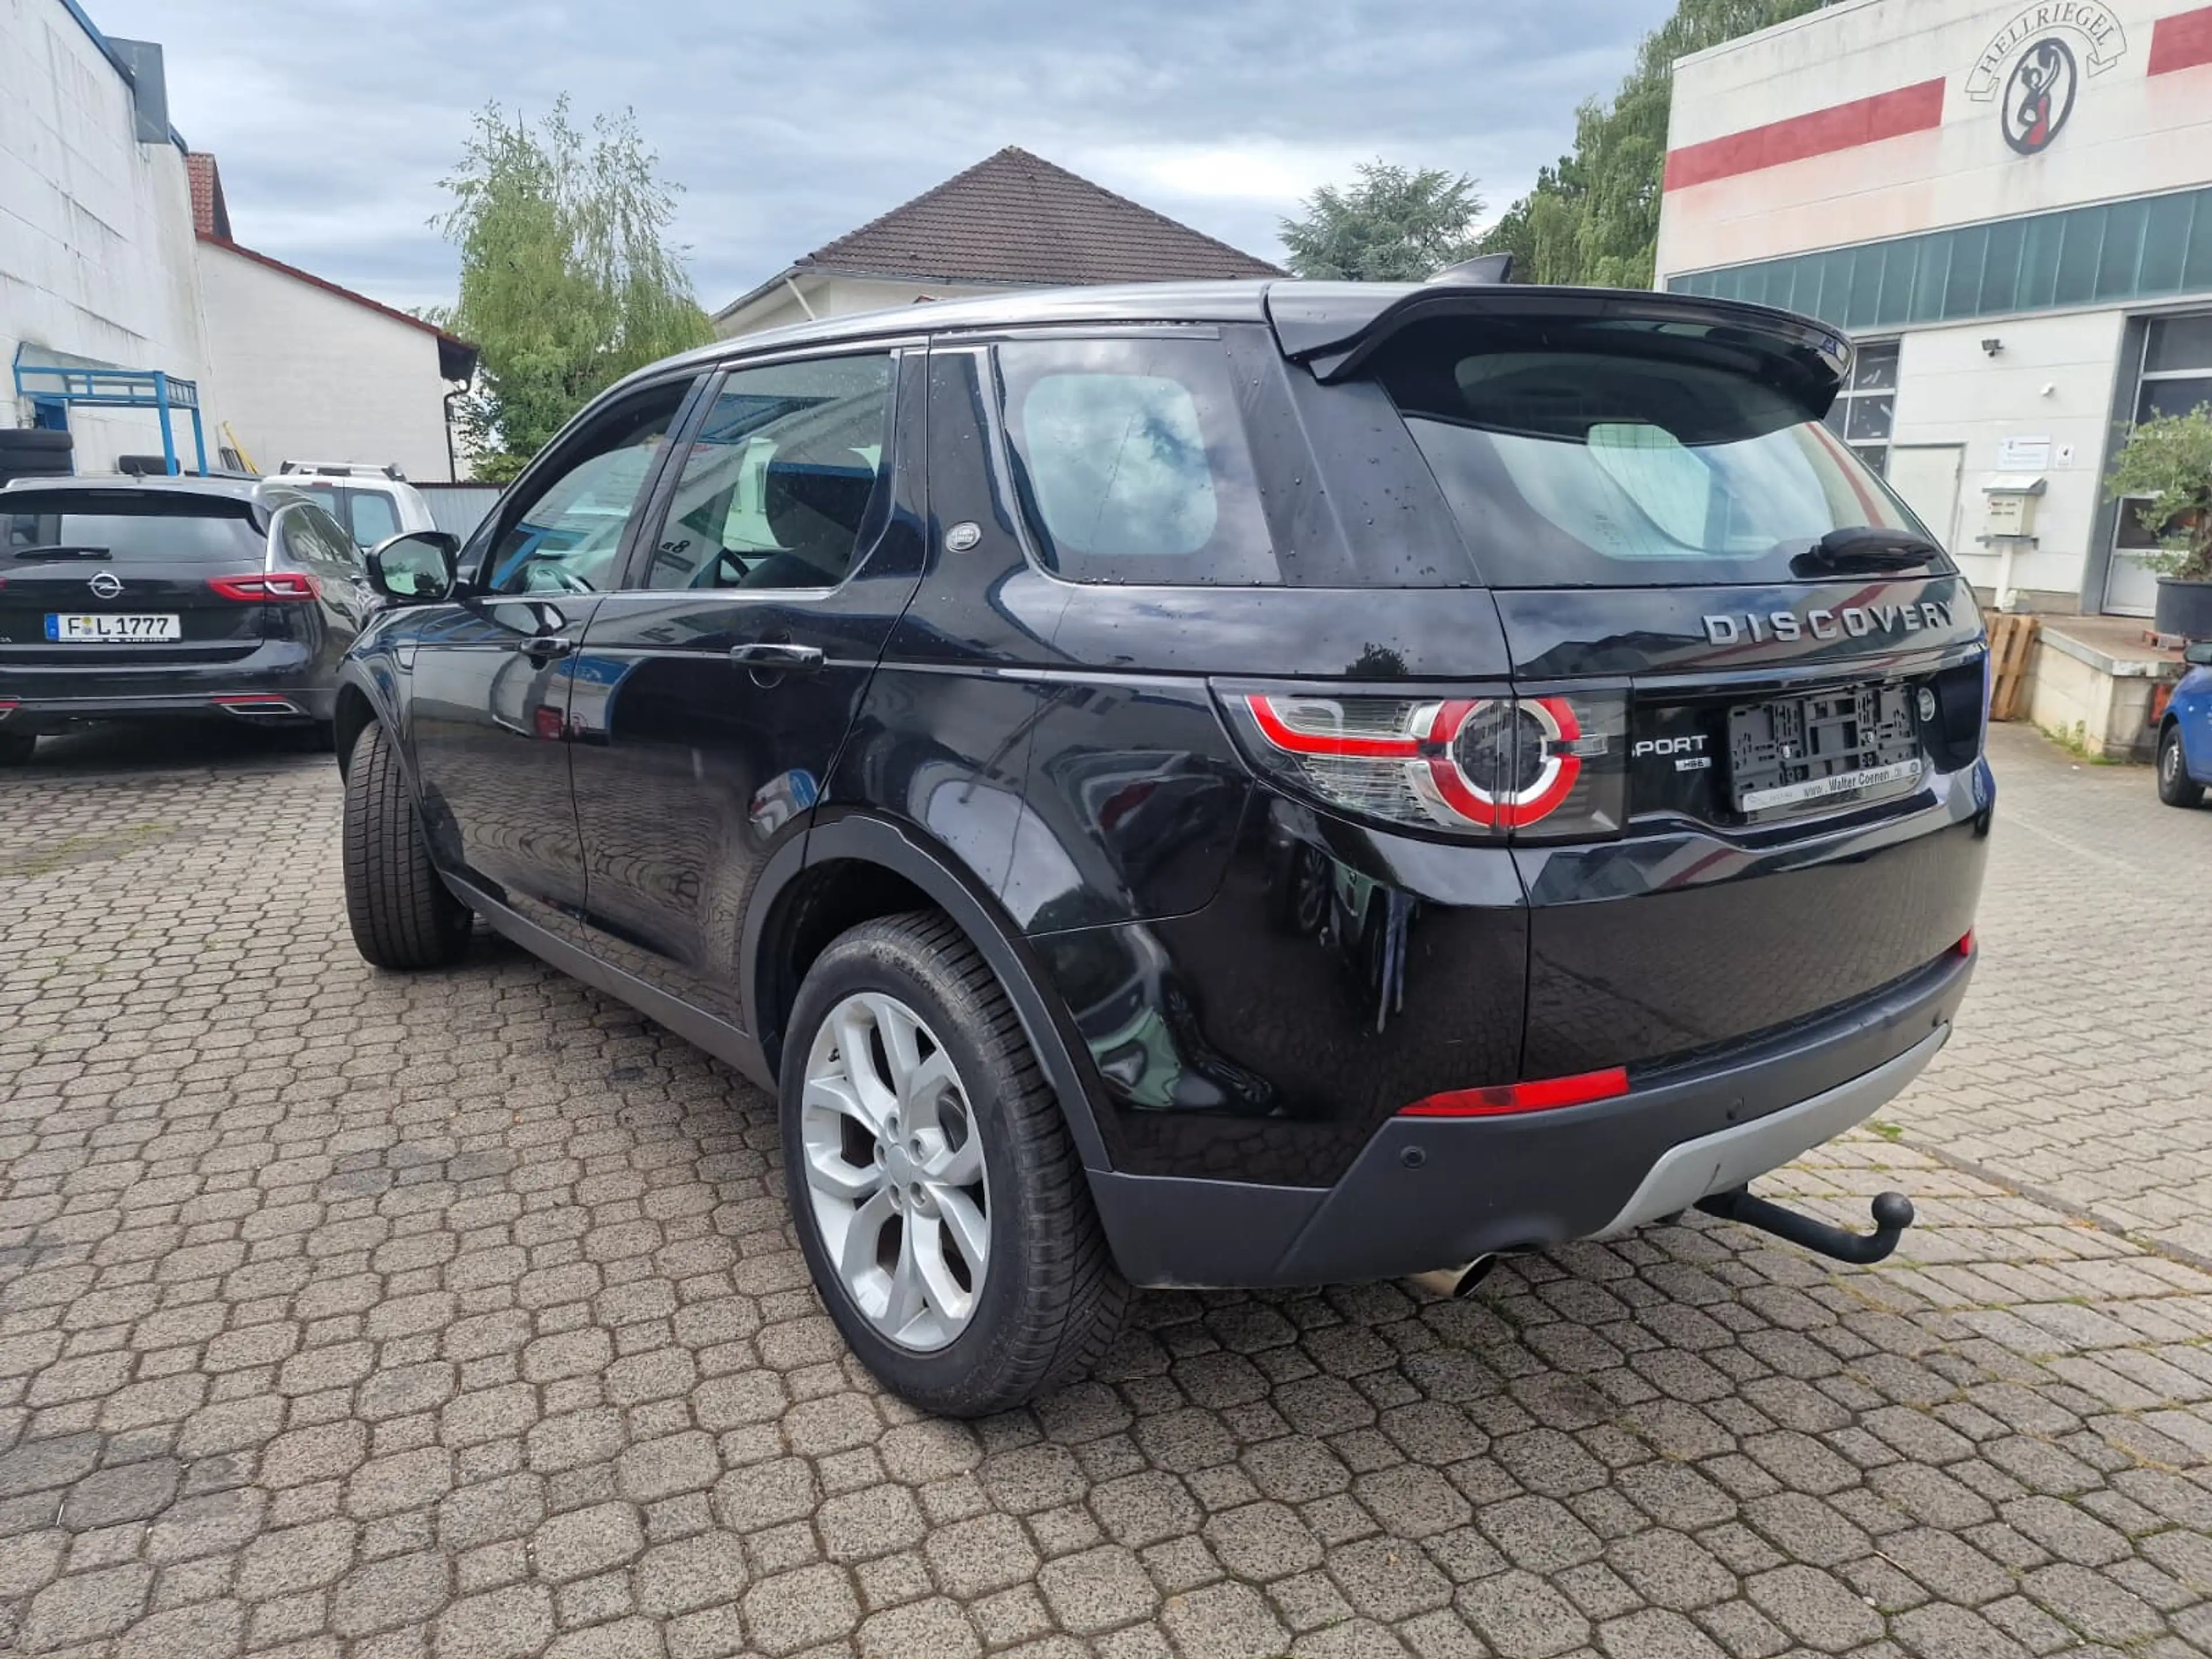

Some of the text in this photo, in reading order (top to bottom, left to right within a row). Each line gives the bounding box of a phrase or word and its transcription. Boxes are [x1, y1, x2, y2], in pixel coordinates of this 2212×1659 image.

[1980, 2, 2114, 74] HELLRIEGEL
[68, 618, 80, 635] F
[1702, 601, 1953, 645] DISCOVERY
[1829, 776, 1856, 791] Walter
